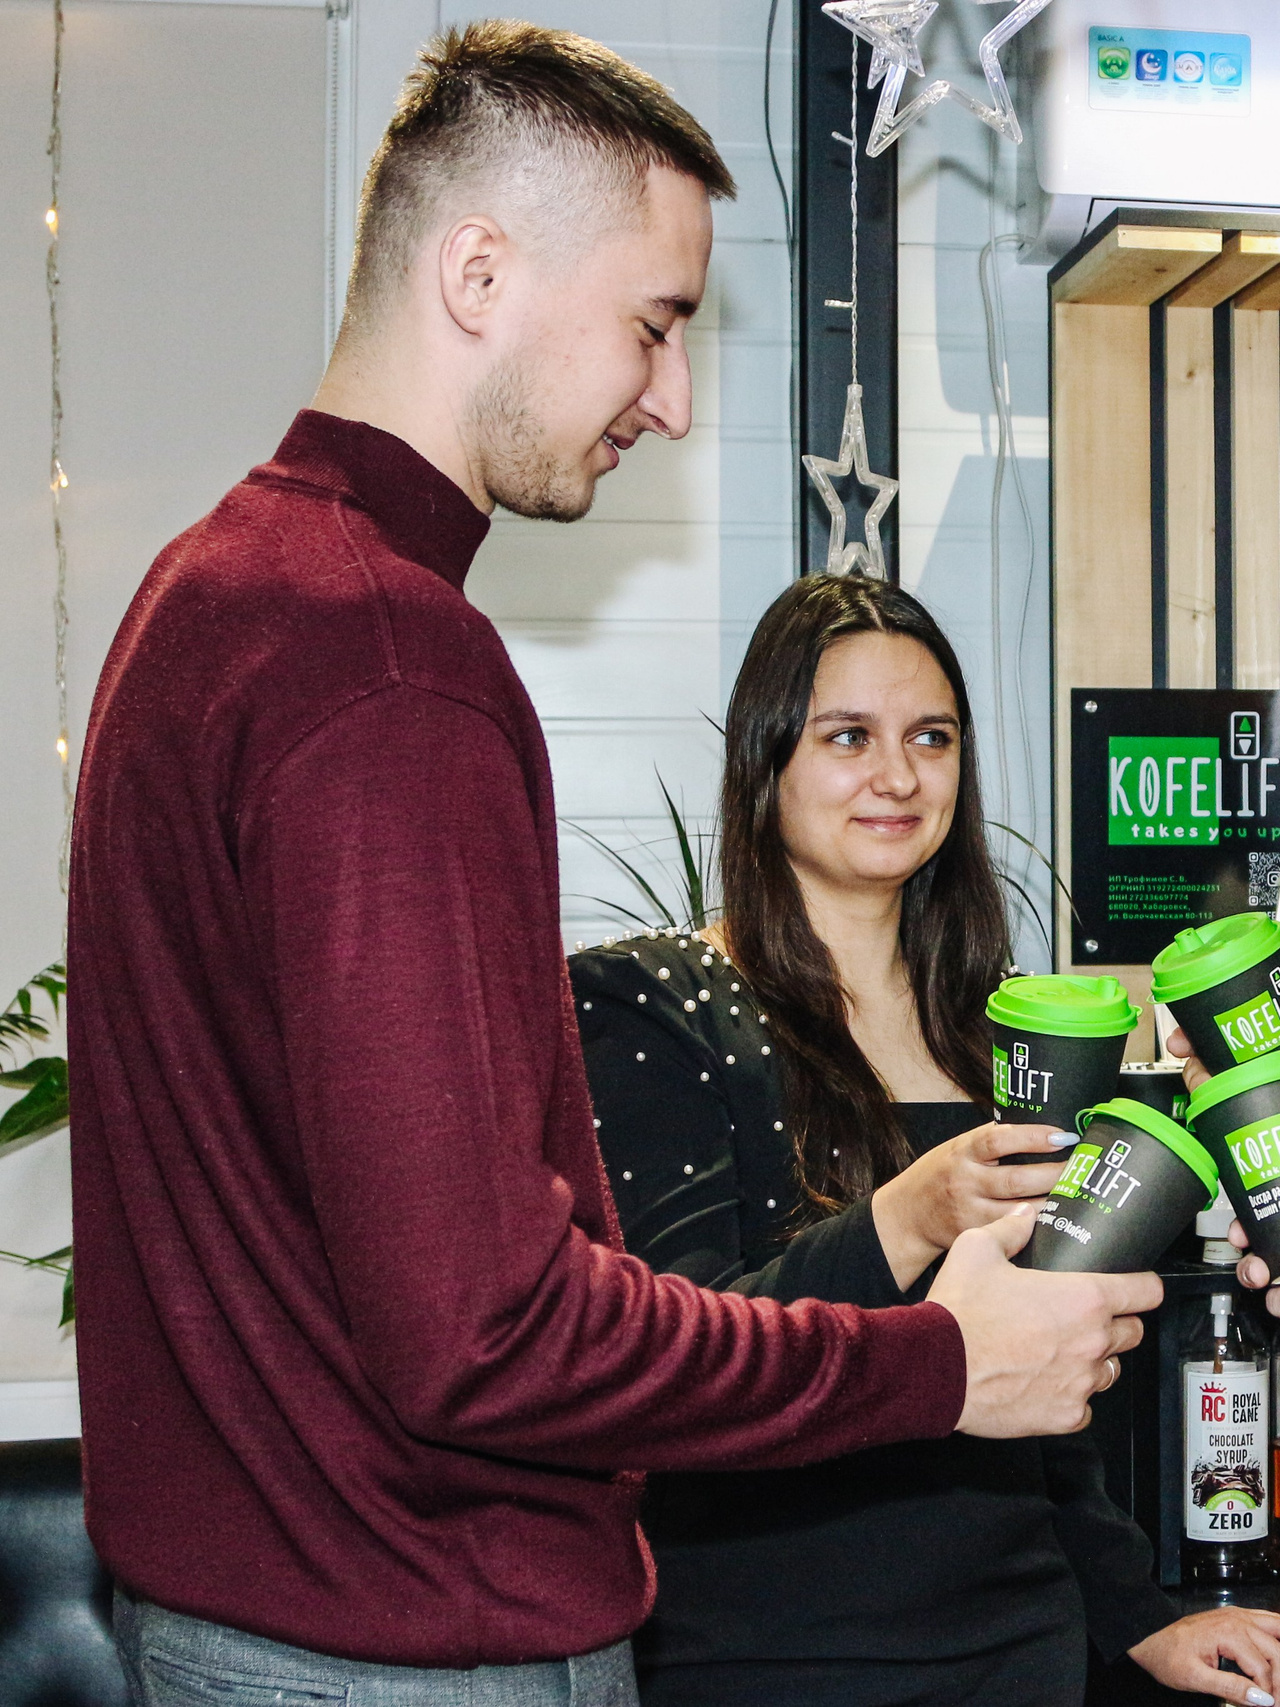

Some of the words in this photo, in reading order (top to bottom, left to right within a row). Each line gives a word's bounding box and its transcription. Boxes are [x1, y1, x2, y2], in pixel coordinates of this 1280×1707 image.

[1131, 823, 1199, 839] takes
[1208, 826, 1248, 842] you
[1108, 875, 1122, 883] ИП
[1123, 875, 1168, 884] Трофимов
[1108, 884, 1145, 892] ОГРНИП
[1007, 1099, 1025, 1109] you
[1028, 1104, 1042, 1113] up
[1075, 1190, 1096, 1204] you
[1098, 1202, 1112, 1214] up
[1202, 1394, 1226, 1422] RC
[1232, 1392, 1262, 1408] ROYAL
[1232, 1407, 1259, 1424] CANE
[1209, 1433, 1254, 1447] CHOCOLATE
[1216, 1449, 1248, 1464] SYRUP
[1208, 1512, 1253, 1530] ZERO
